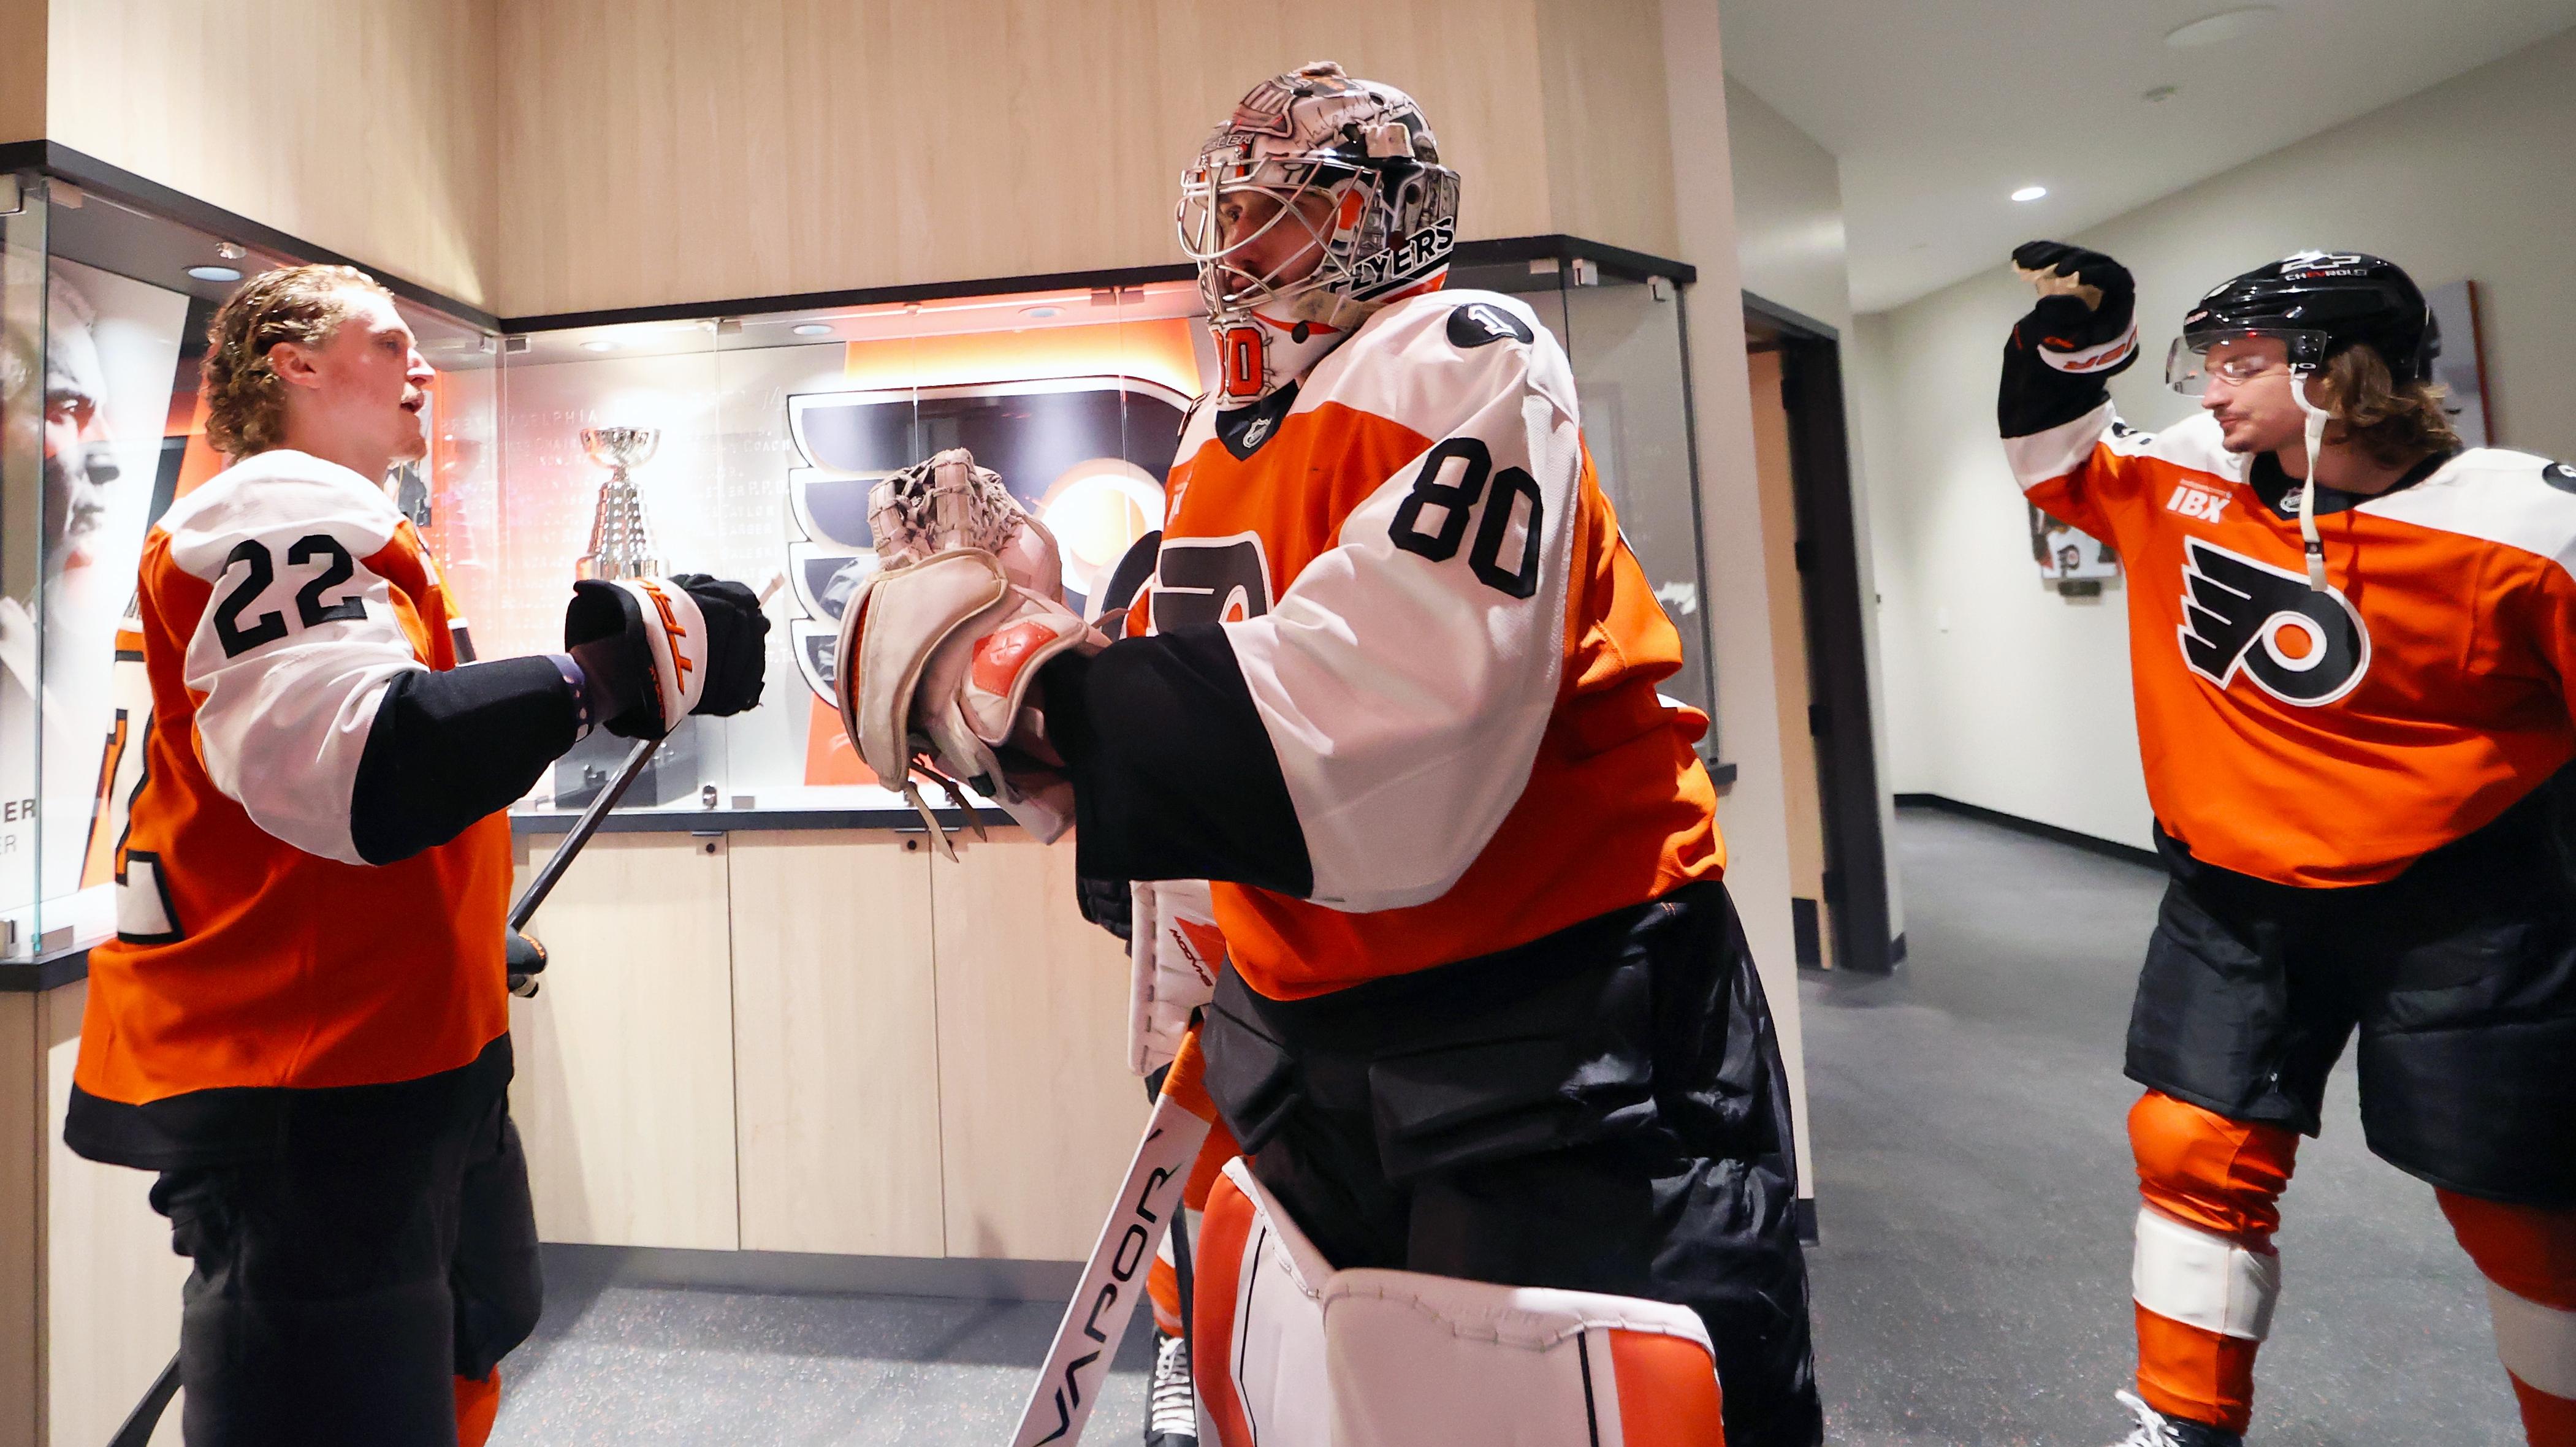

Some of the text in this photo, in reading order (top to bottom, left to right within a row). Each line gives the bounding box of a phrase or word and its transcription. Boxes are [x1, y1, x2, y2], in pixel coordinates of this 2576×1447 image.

[1467, 304, 1519, 336] 1
[1388, 437, 1544, 599] 80
[2166, 485, 2230, 524] IBX
[213, 534, 368, 658] 22
[0, 798, 36, 823] ER
[1033, 1161, 1184, 1447] VAPOR
